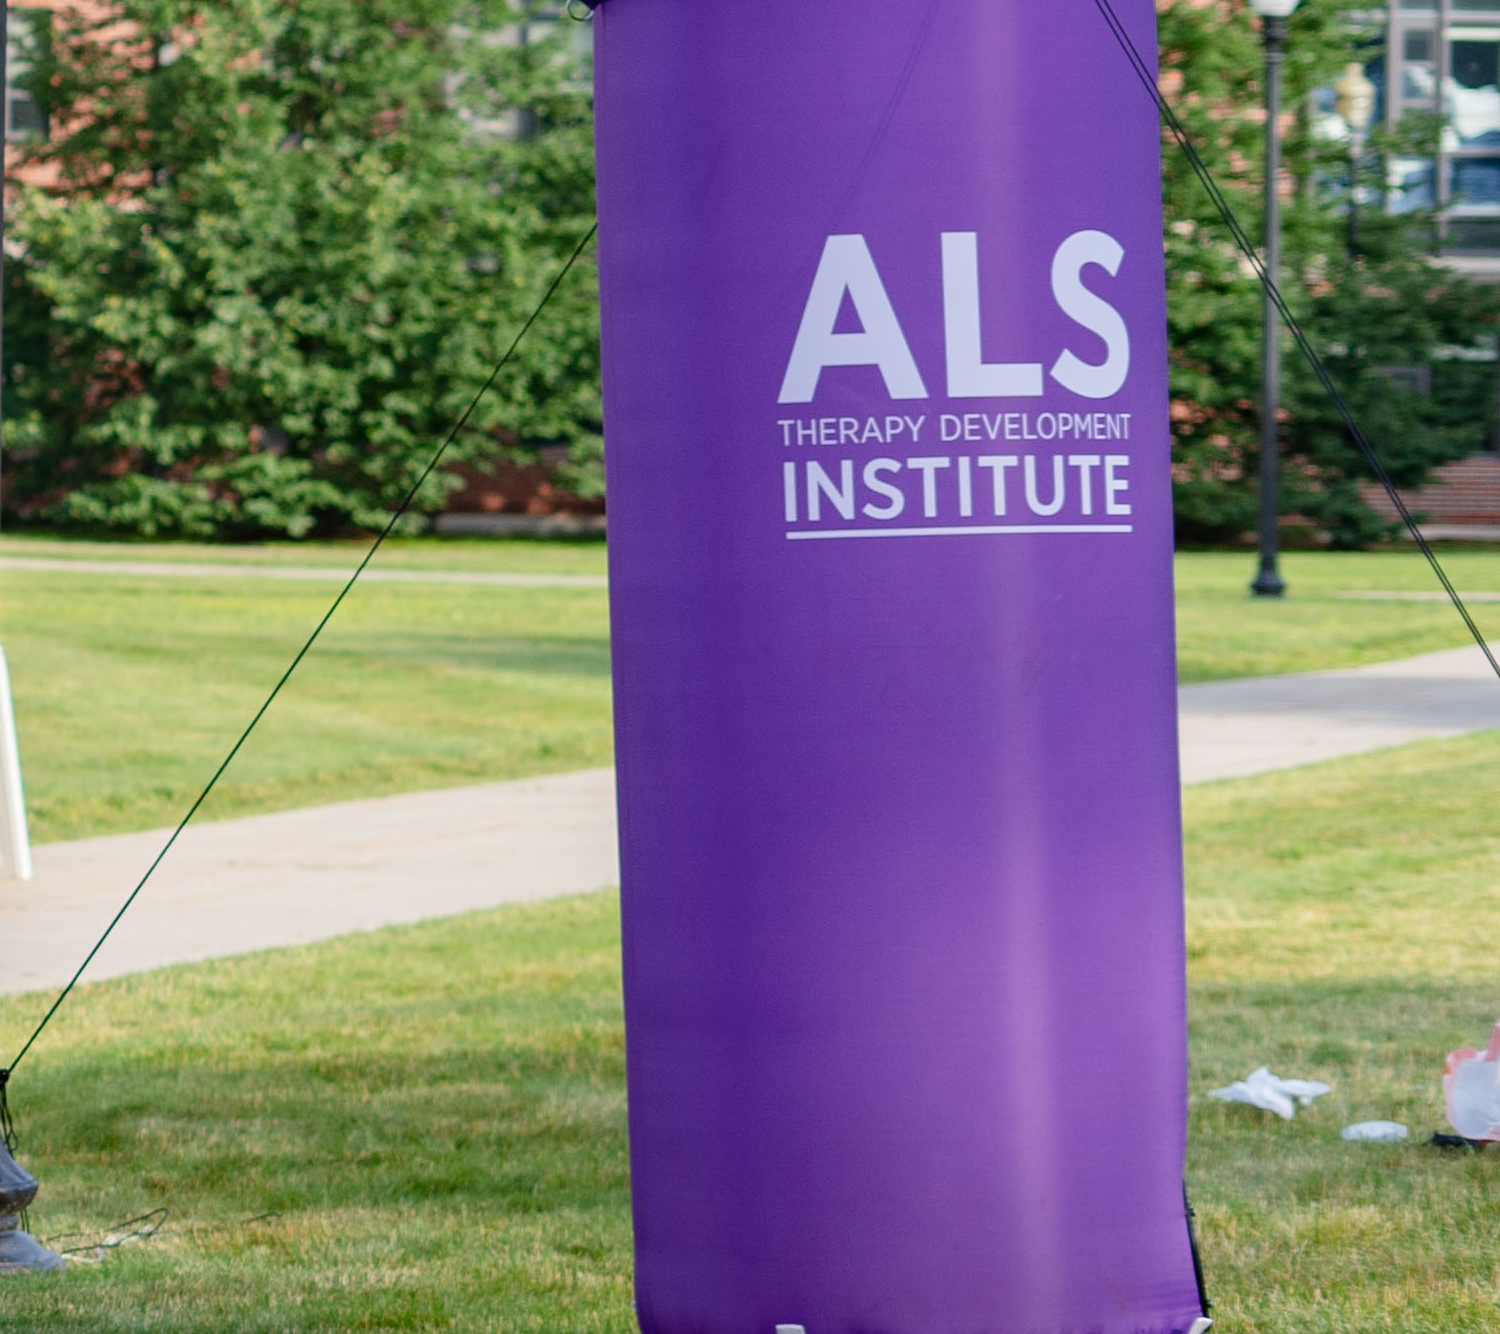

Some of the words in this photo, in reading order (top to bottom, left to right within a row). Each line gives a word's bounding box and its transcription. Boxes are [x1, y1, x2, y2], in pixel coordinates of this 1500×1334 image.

[777, 229, 1130, 404] ALS
[777, 415, 926, 446] THERAPY
[940, 412, 1131, 441] DEVELOPMENT
[783, 454, 1132, 523] INSTITUTE
